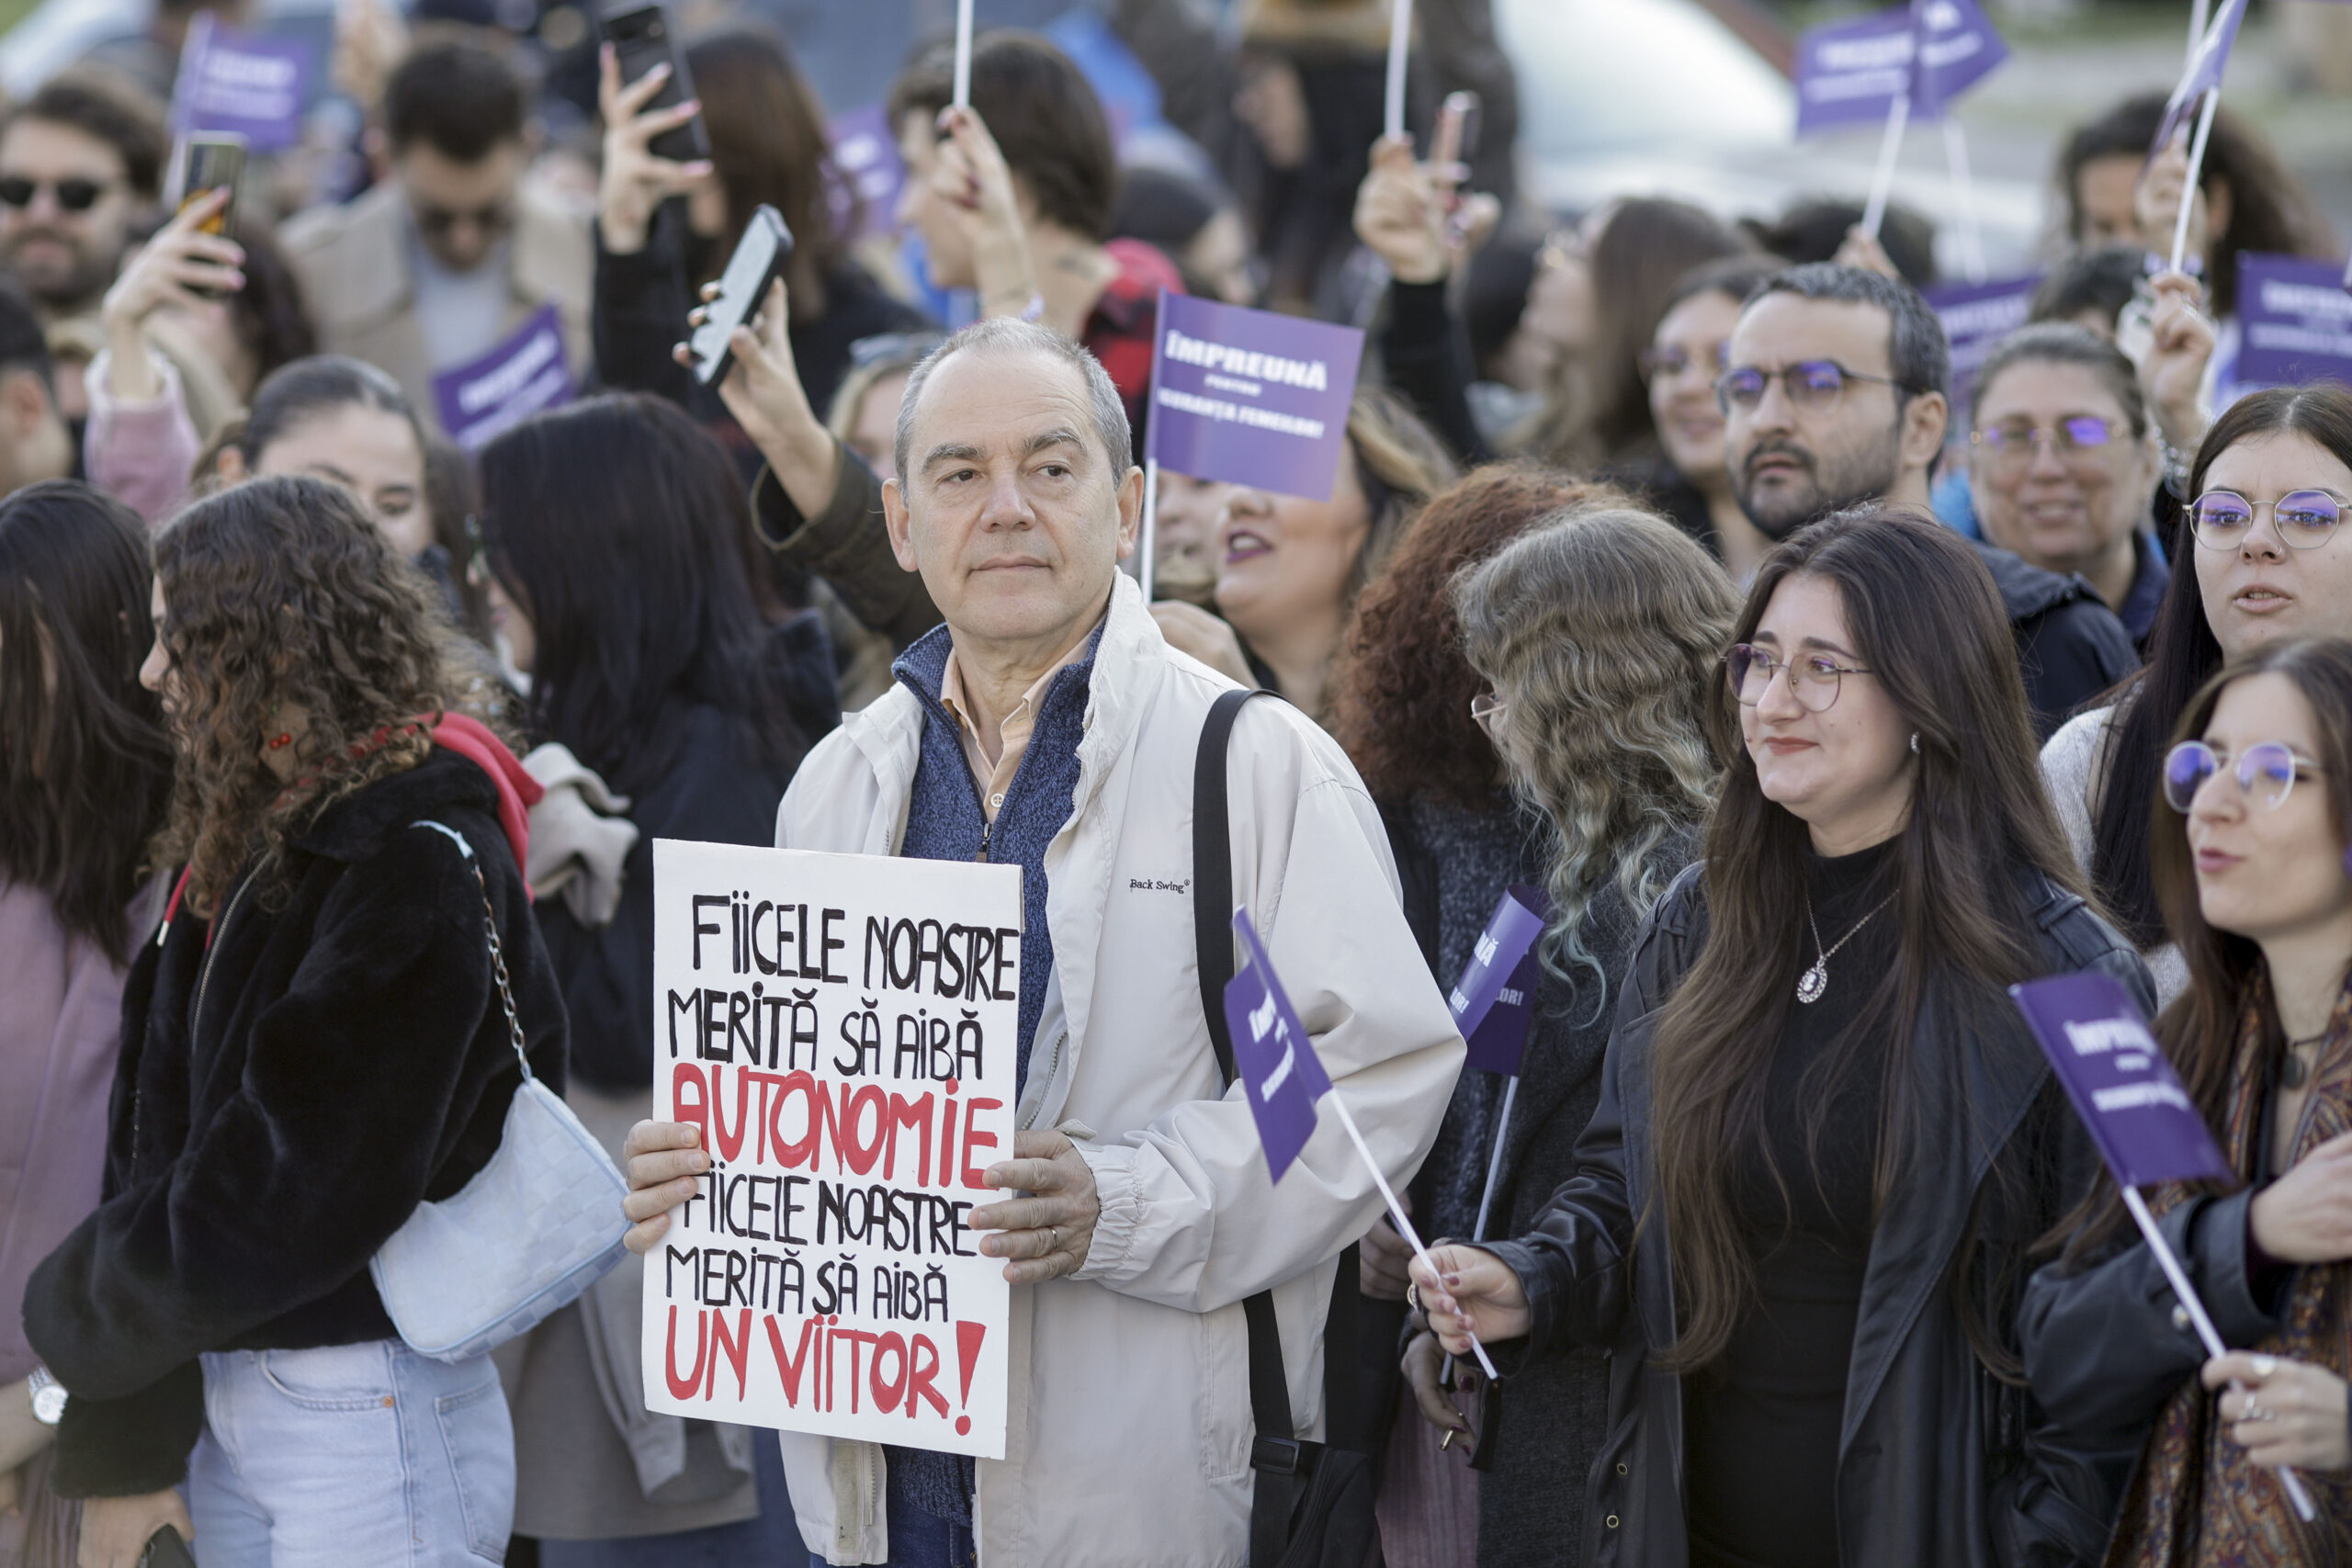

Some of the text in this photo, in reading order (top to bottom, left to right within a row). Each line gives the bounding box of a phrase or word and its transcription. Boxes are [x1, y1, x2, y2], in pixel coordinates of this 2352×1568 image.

[1130, 879, 1153, 890] Back
[863, 915, 1021, 1002] NOASTRE
[833, 996, 881, 1077] SĂ
[818, 1179, 978, 1258] NOASTRE
[812, 1253, 858, 1315] SĂ
[665, 1304, 752, 1403] UN
